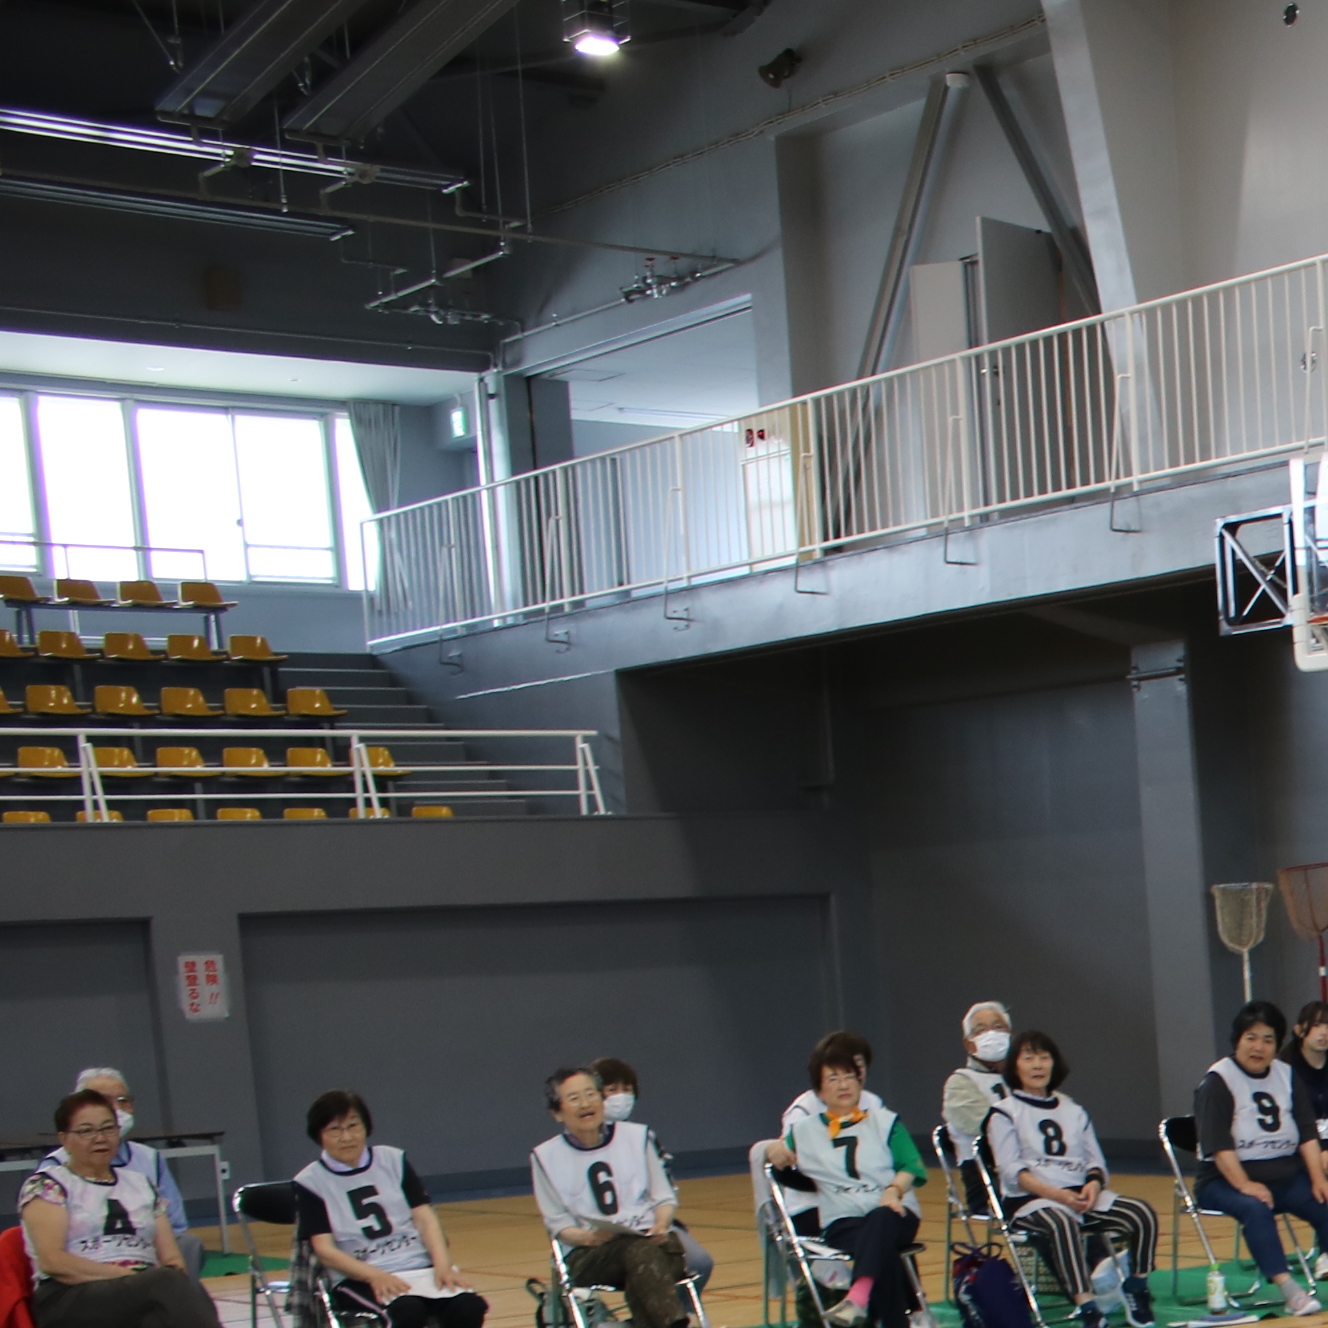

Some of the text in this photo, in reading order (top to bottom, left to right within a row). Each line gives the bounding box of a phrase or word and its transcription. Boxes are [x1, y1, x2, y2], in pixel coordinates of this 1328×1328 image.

[1252, 1091, 1281, 1133] 9
[832, 1136, 860, 1181] 7
[1038, 1119, 1067, 1156] 8
[587, 1161, 619, 1216] 6
[346, 1184, 393, 1240] 5
